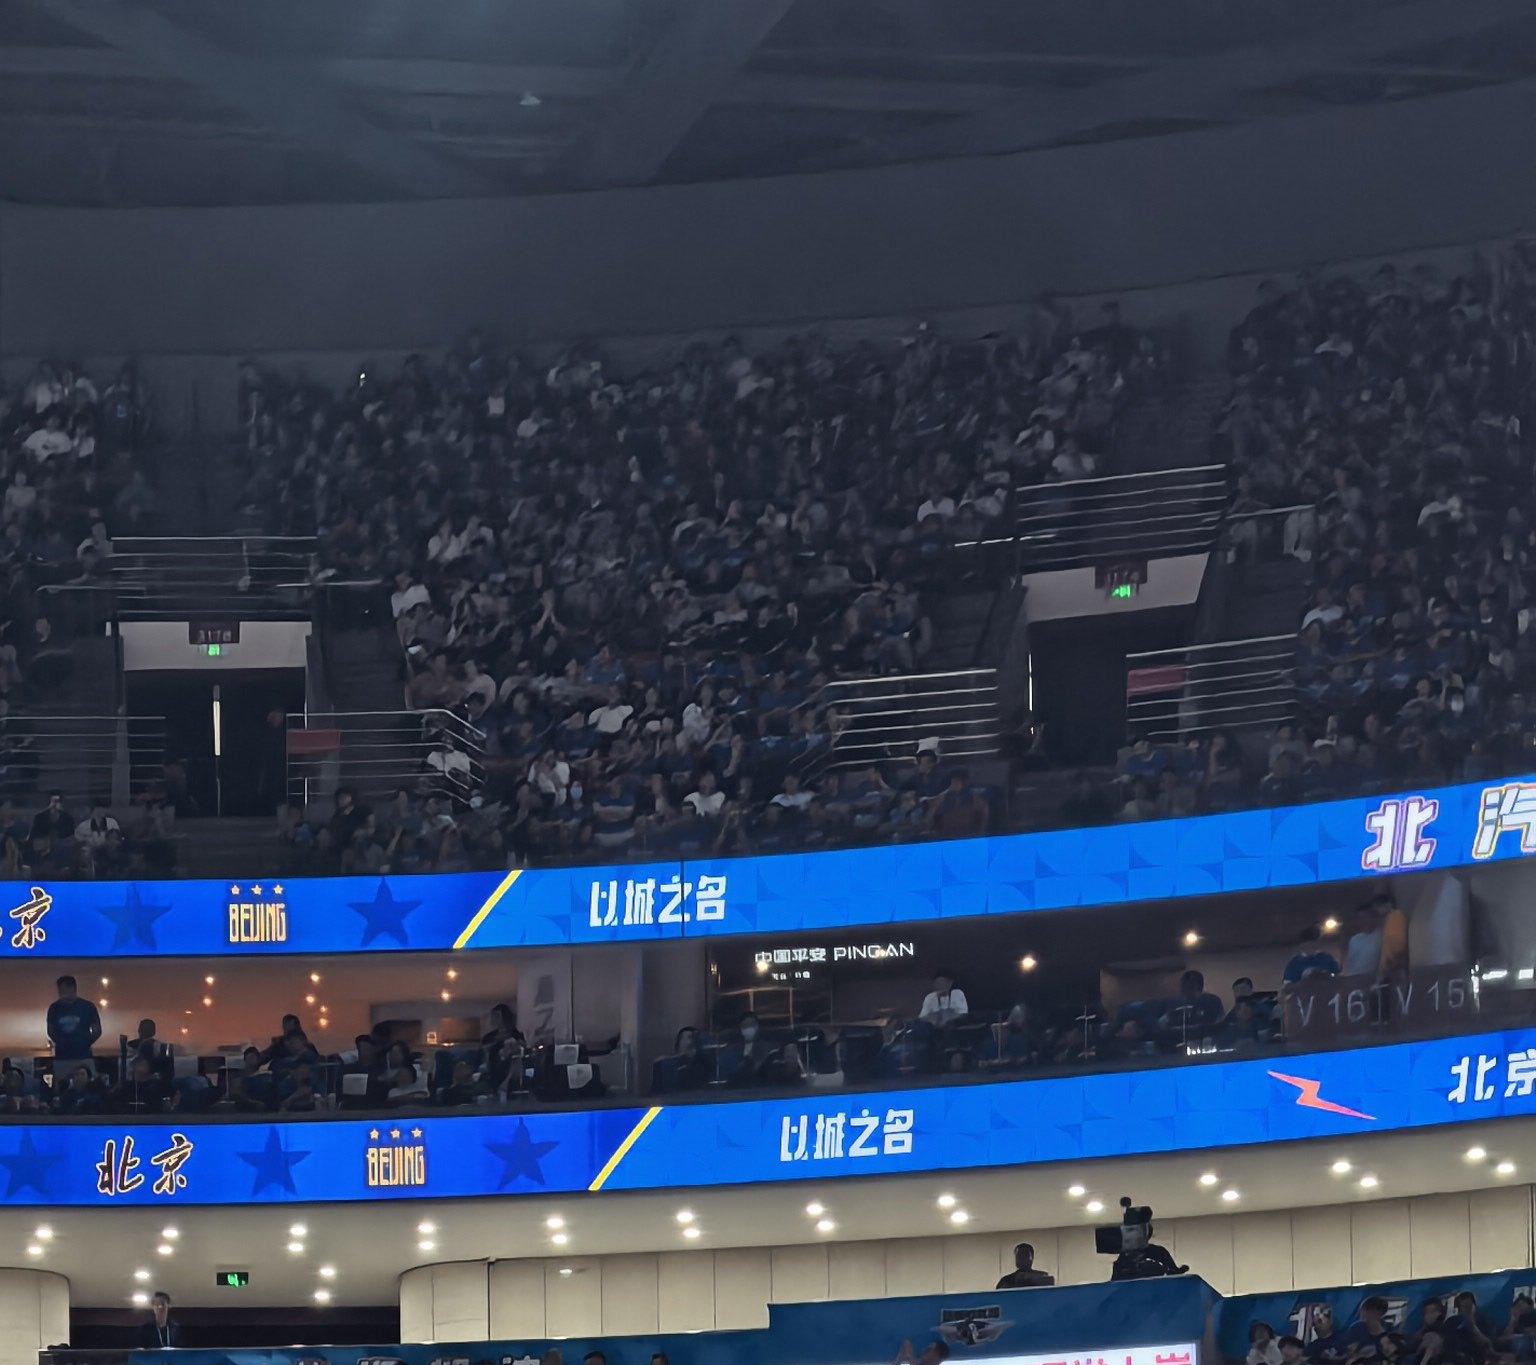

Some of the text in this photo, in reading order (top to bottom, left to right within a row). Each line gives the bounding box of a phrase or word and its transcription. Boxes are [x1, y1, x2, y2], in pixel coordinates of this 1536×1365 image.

[589, 875, 727, 929] 以城之名
[1296, 989, 1364, 1027] V 16
[1396, 982, 1413, 1017] V
[780, 1109, 914, 1162] 以城之名
[95, 1132, 194, 1197] 北京
